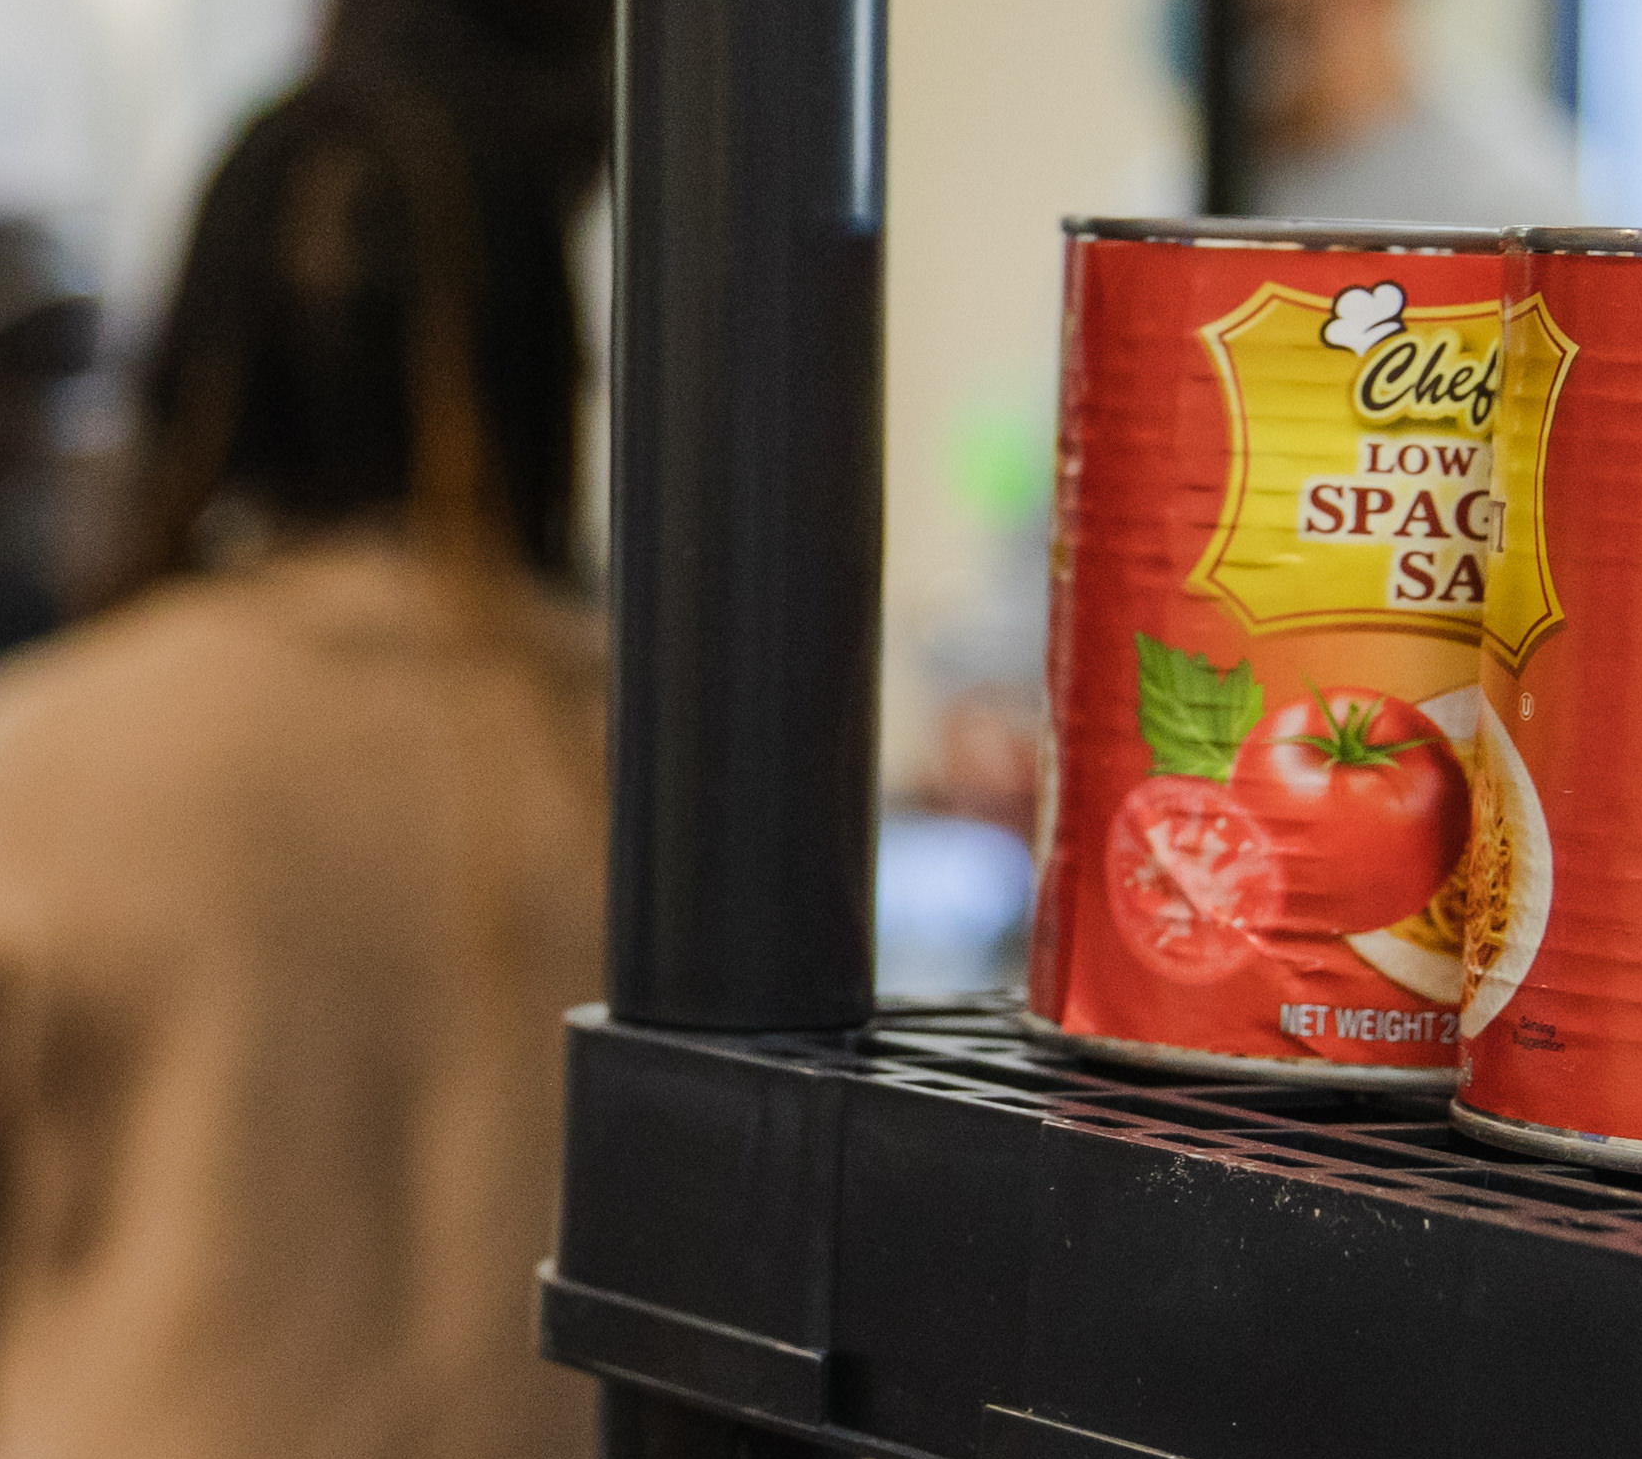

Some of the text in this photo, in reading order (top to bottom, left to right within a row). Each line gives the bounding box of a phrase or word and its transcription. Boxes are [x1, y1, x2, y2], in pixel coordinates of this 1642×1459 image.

[1361, 341, 1500, 426] Chef
[1366, 443, 1479, 477] LOW
[1280, 1003, 1329, 1037] NET
[1336, 1008, 1438, 1043] WEIGHT
